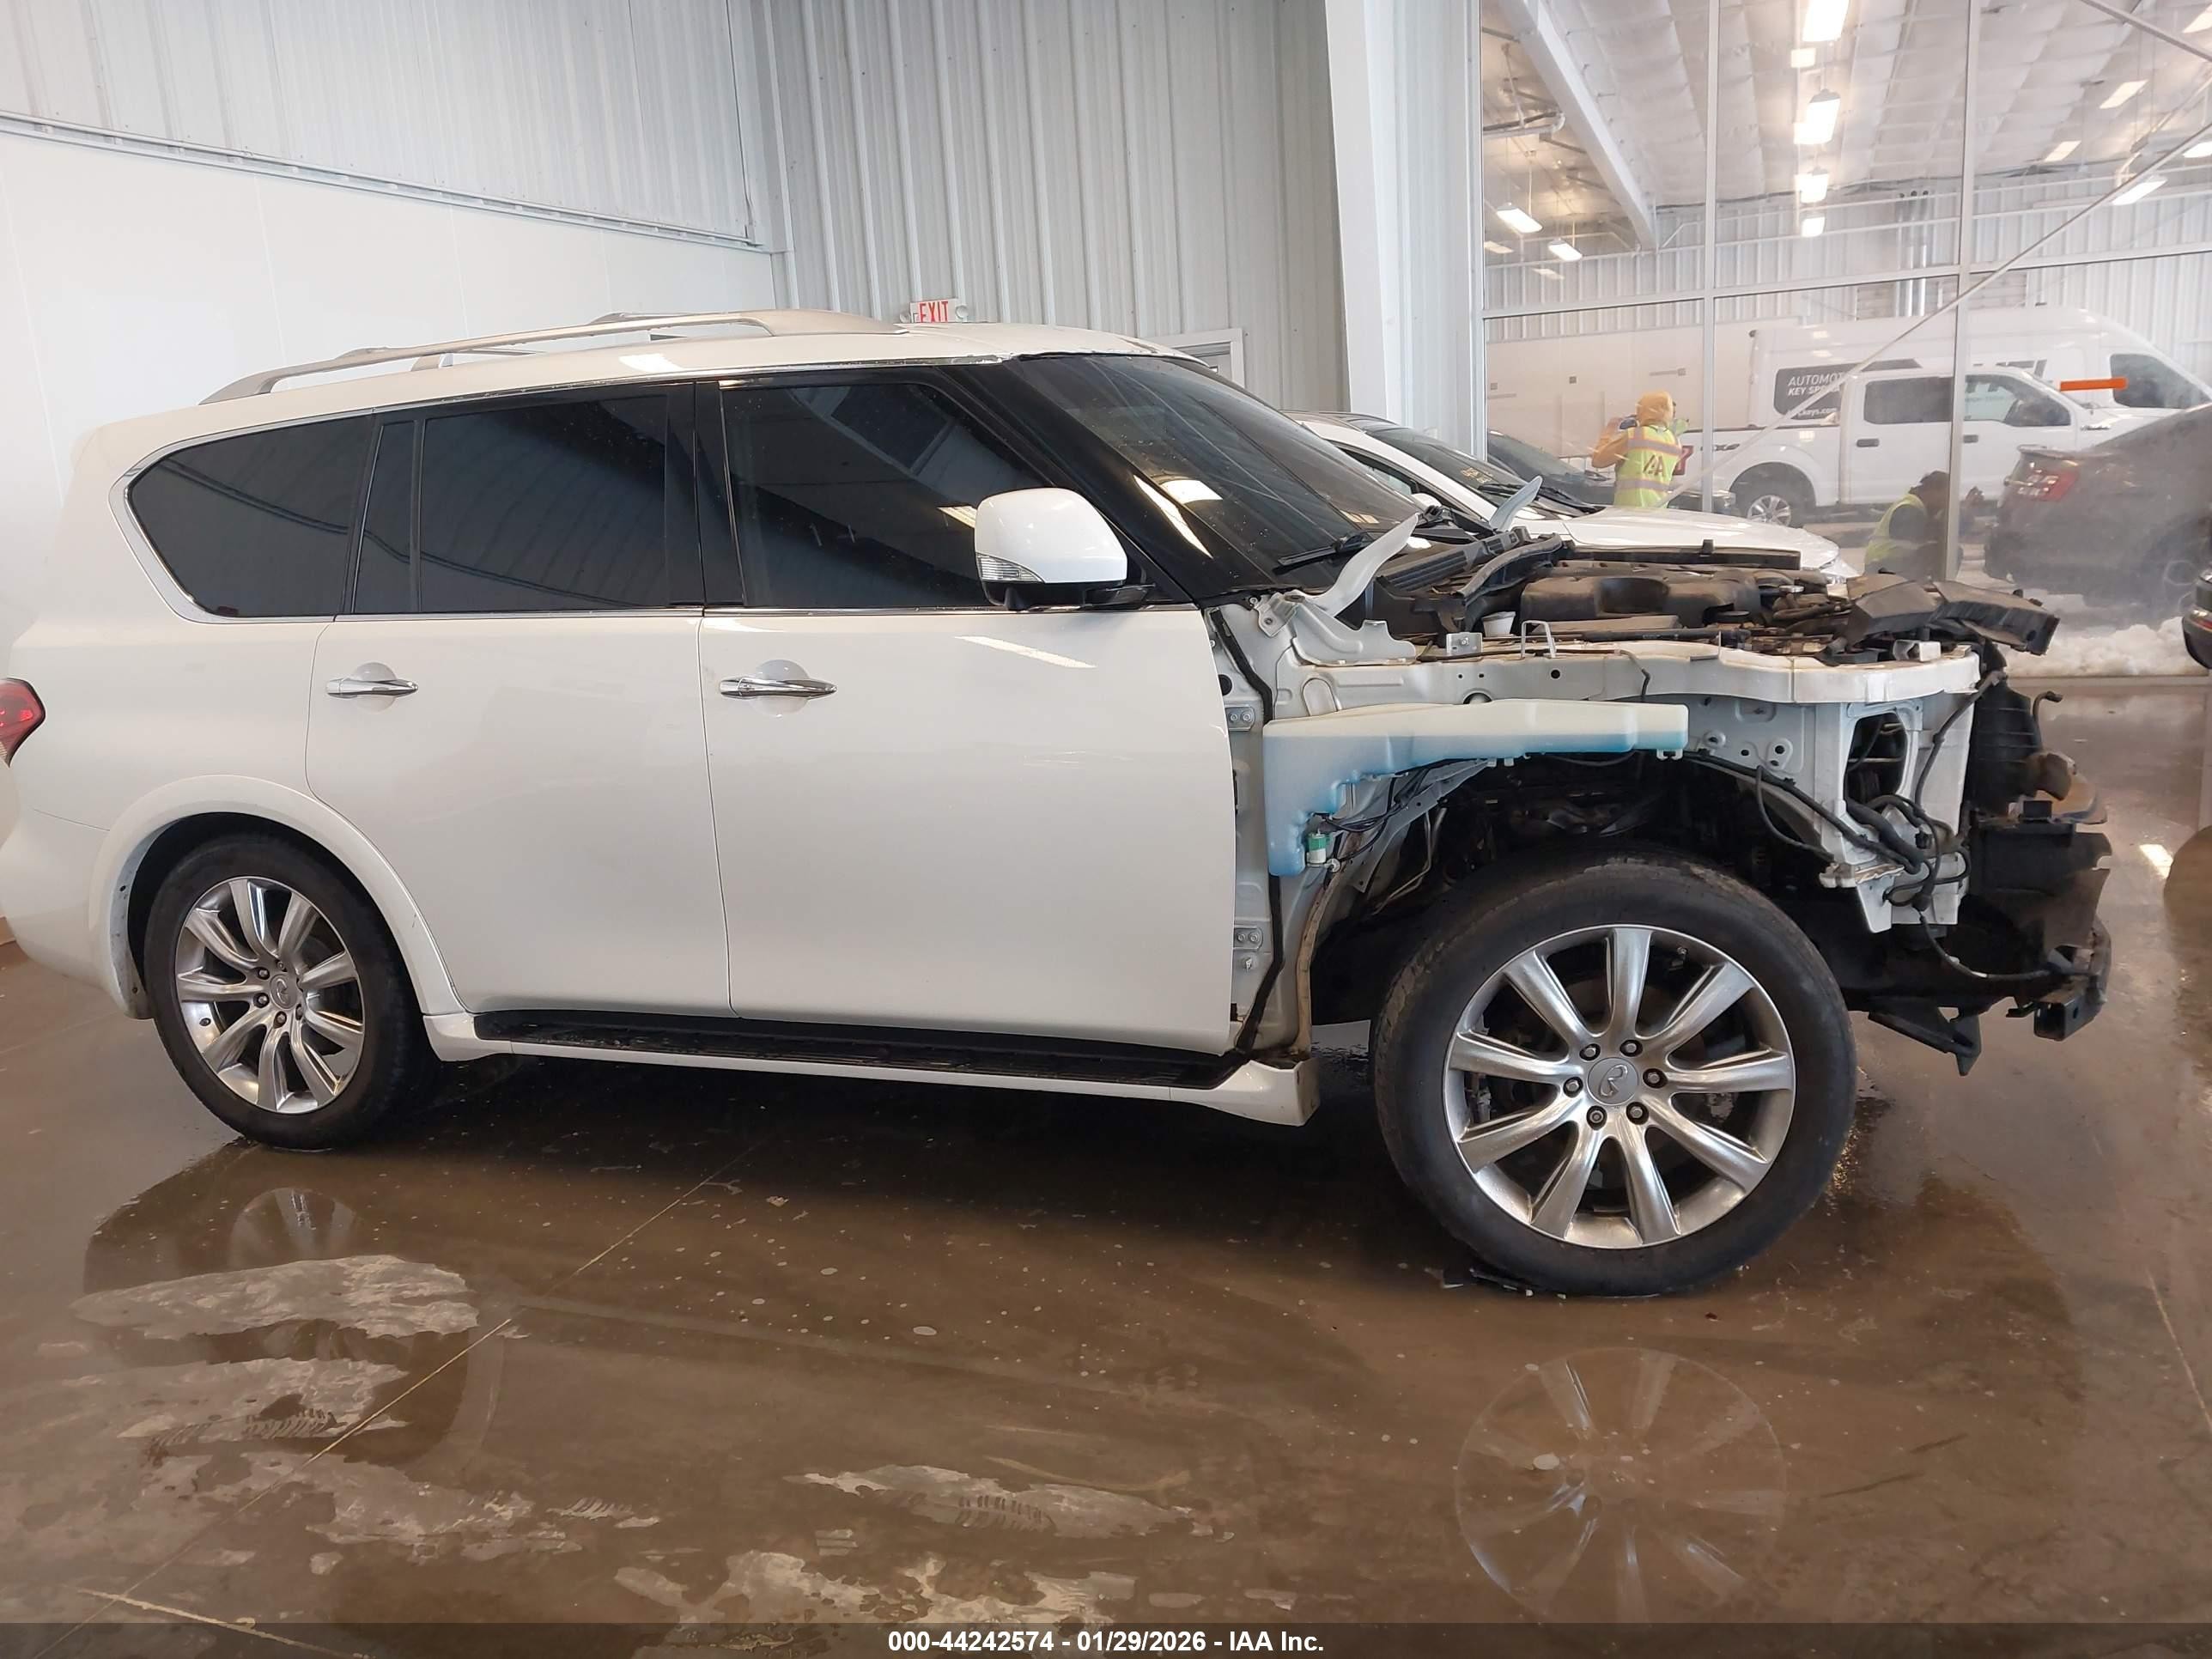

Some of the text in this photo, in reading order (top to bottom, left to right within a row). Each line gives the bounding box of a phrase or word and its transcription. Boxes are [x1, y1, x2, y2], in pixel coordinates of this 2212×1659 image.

[920, 301, 948, 323] EXIT
[1788, 372, 1845, 386] AUTOMOT
[1788, 386, 1807, 396] KEY
